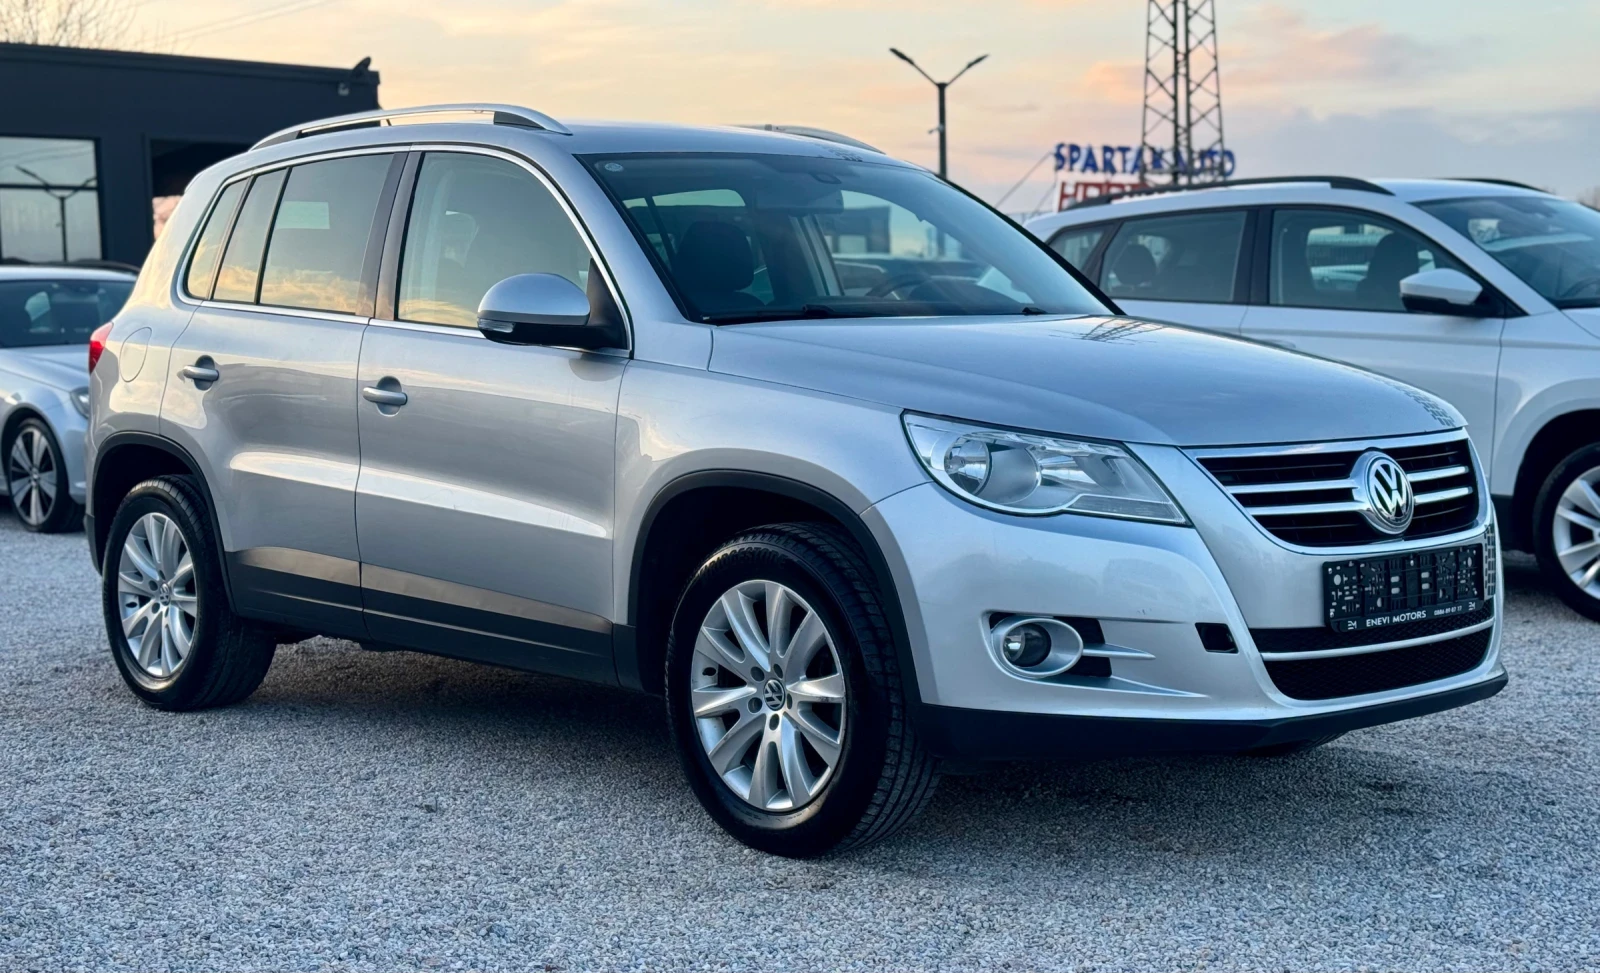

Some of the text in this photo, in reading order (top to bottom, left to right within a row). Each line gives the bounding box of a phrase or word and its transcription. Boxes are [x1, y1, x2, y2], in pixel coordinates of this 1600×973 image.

[1055, 143, 1163, 174] SPARTAK
[1369, 457, 1410, 522] VW
[1366, 615, 1390, 627] ENEVI
[1392, 610, 1427, 623] MOTORS
